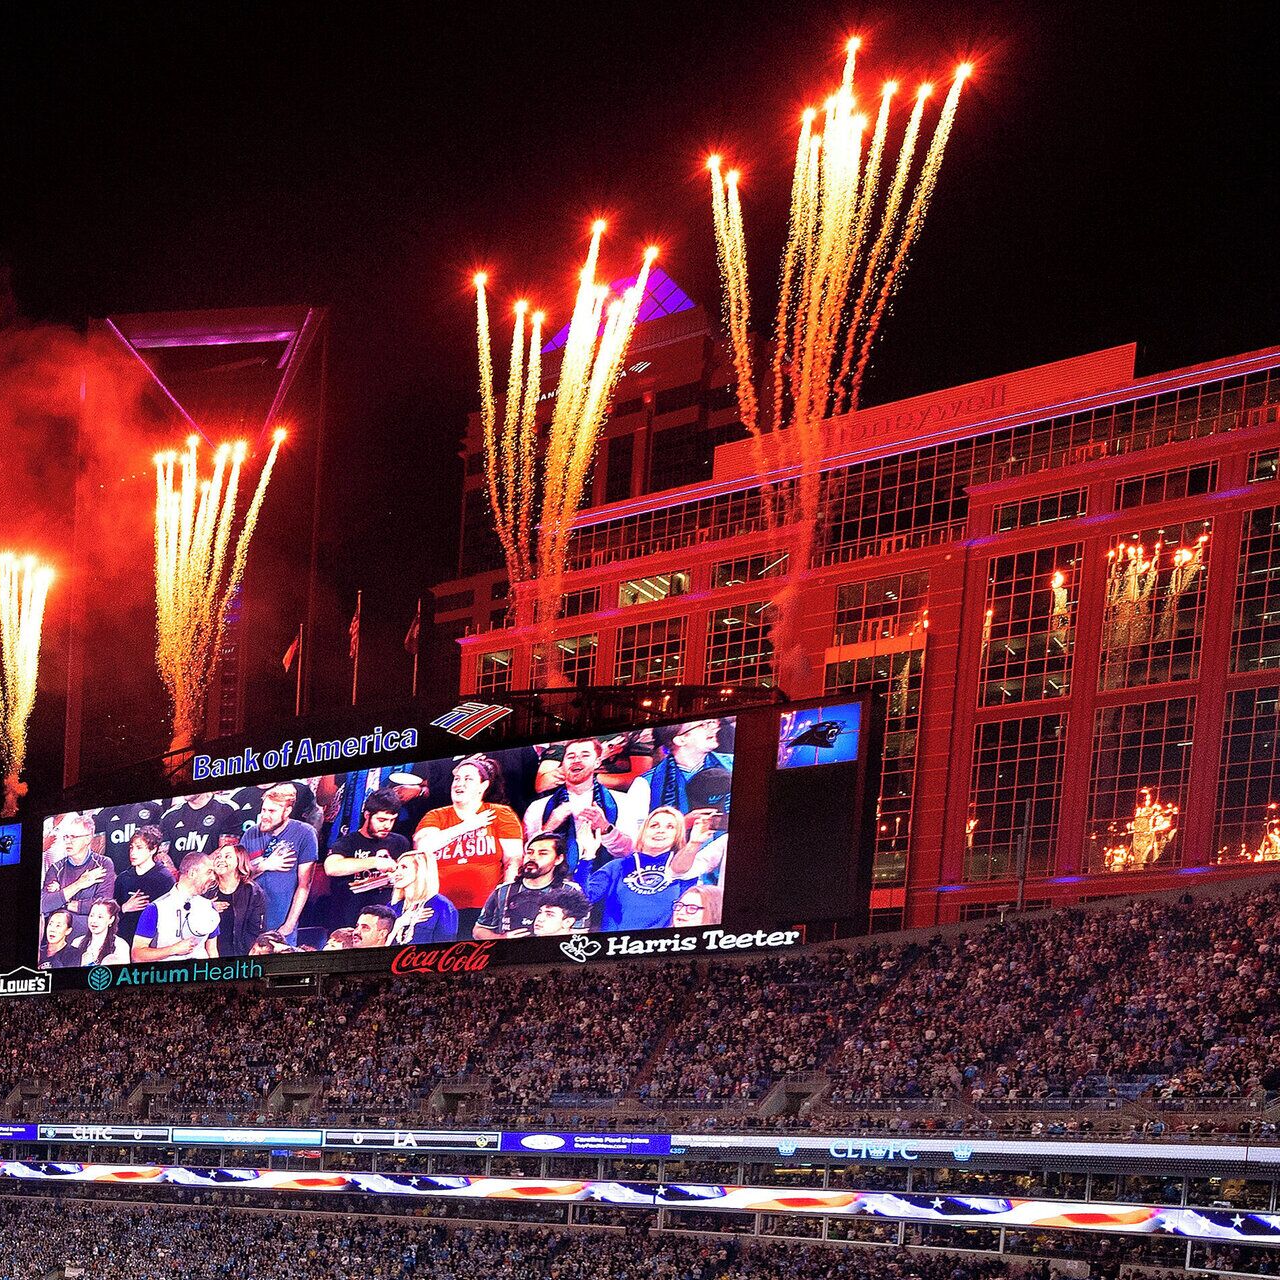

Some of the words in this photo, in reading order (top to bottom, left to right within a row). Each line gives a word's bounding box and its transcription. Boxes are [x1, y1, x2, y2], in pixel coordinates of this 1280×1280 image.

[192, 748, 260, 780] Bank
[262, 741, 293, 769] of
[294, 726, 418, 765] America
[111, 824, 140, 844] all
[175, 831, 209, 853] ally
[605, 933, 697, 956] Harris
[702, 929, 800, 951] Teeter
[391, 941, 496, 975] Coca-Cola
[0, 976, 46, 993] LOWE'S
[115, 966, 189, 986] Atrium
[192, 959, 262, 981] Health
[394, 1132, 418, 1147] LA
